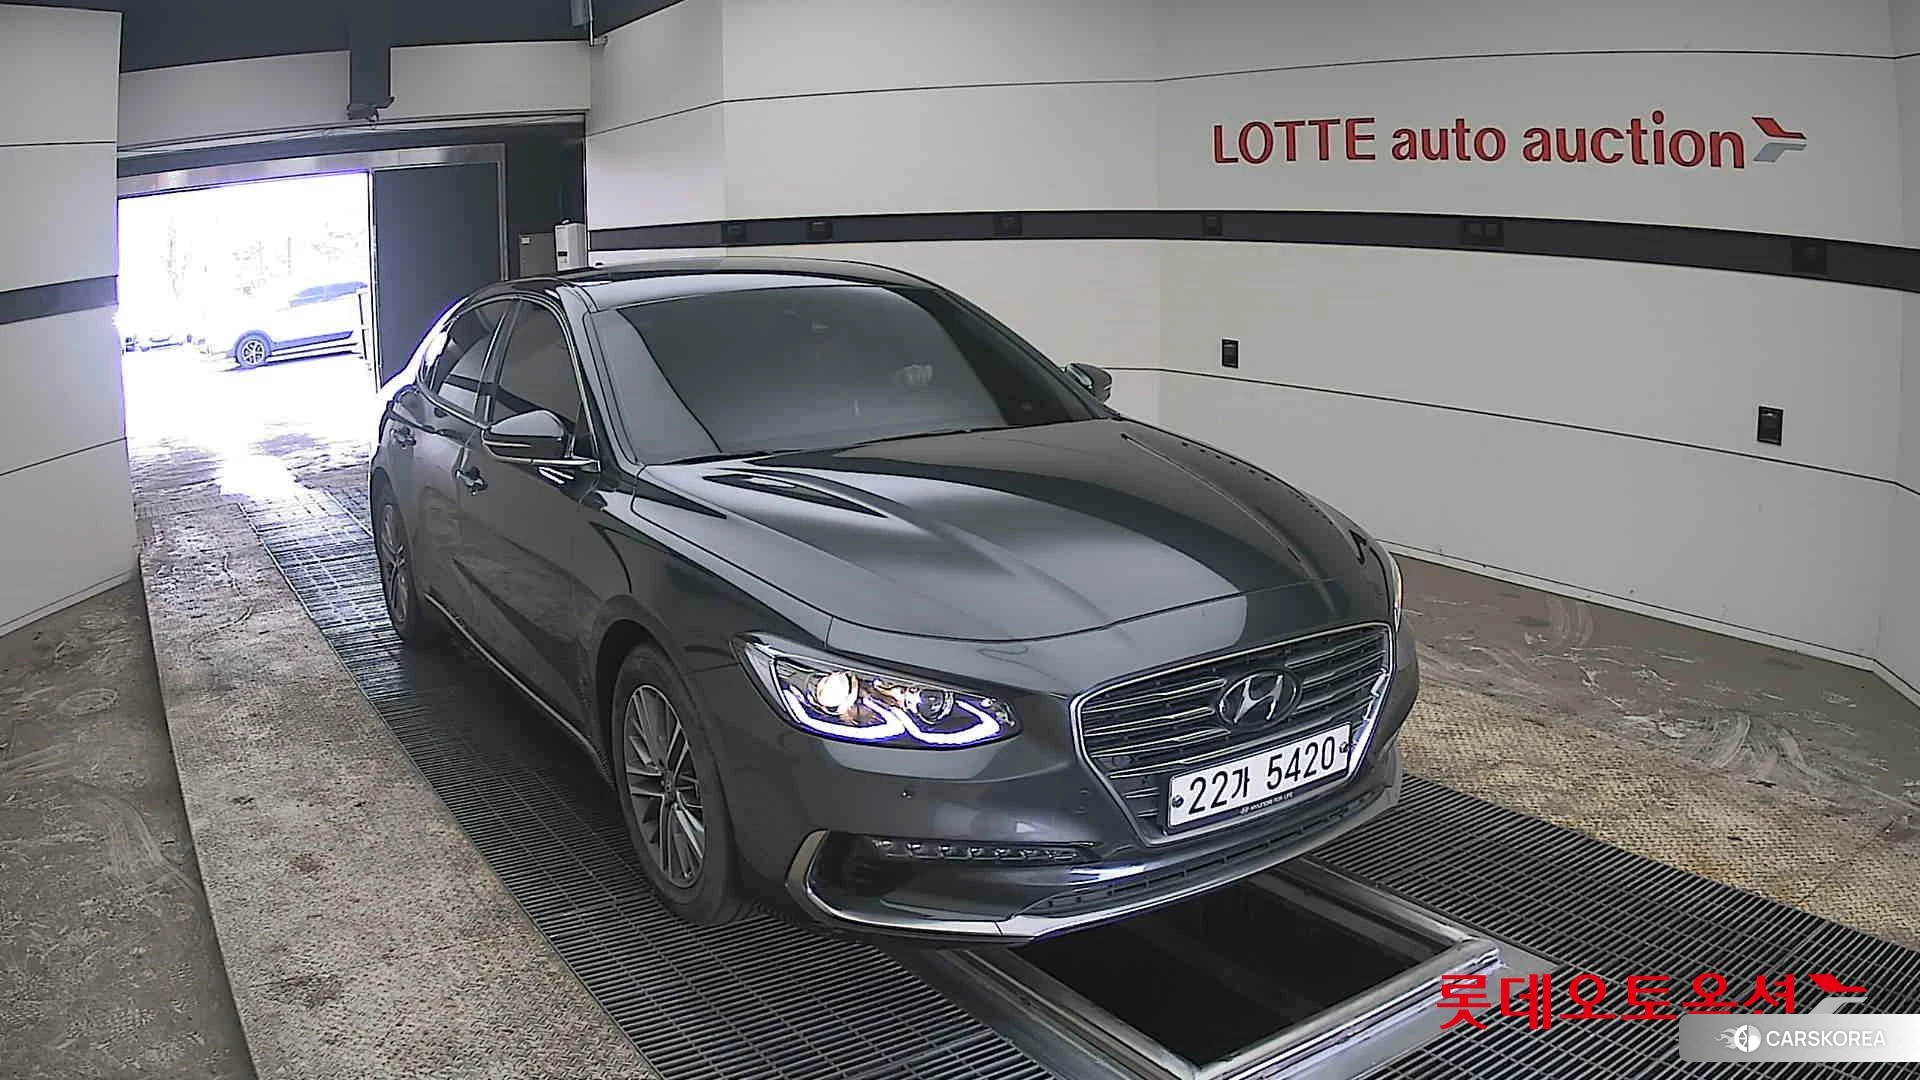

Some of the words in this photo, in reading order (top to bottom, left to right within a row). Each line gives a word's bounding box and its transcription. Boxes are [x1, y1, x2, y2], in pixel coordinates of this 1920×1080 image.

[1213, 117, 1376, 164] LOTTE
[1391, 117, 1506, 161] auto
[1522, 110, 1745, 169] auction
[1188, 766, 1250, 815] 22가
[1266, 736, 1336, 790] 5420
